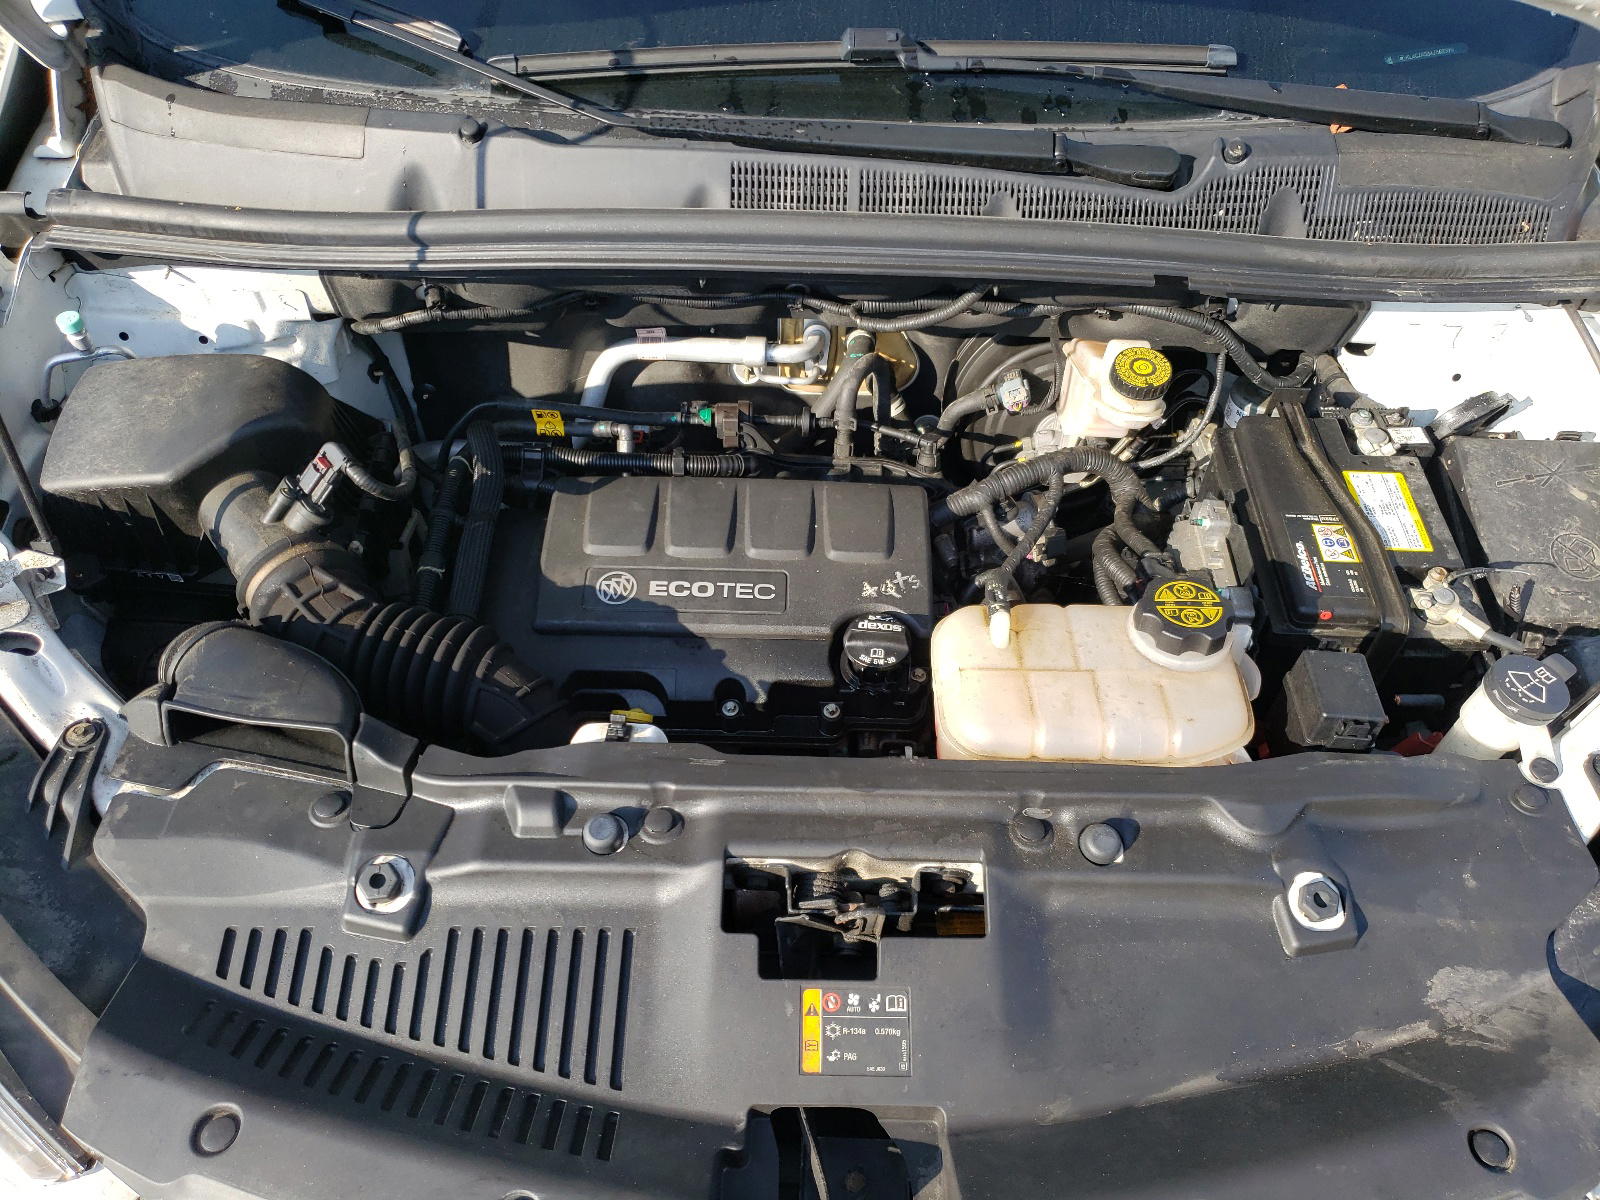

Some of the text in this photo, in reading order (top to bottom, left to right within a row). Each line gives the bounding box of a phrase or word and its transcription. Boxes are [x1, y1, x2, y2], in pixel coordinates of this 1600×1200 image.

[1295, 541, 1318, 591] ACDelco
[648, 580, 776, 600] ECOTEC
[857, 619, 903, 632] dexos
[859, 653, 873, 664] SAE
[846, 1005, 861, 1013] AUTO
[843, 1052, 857, 1061] PAG
